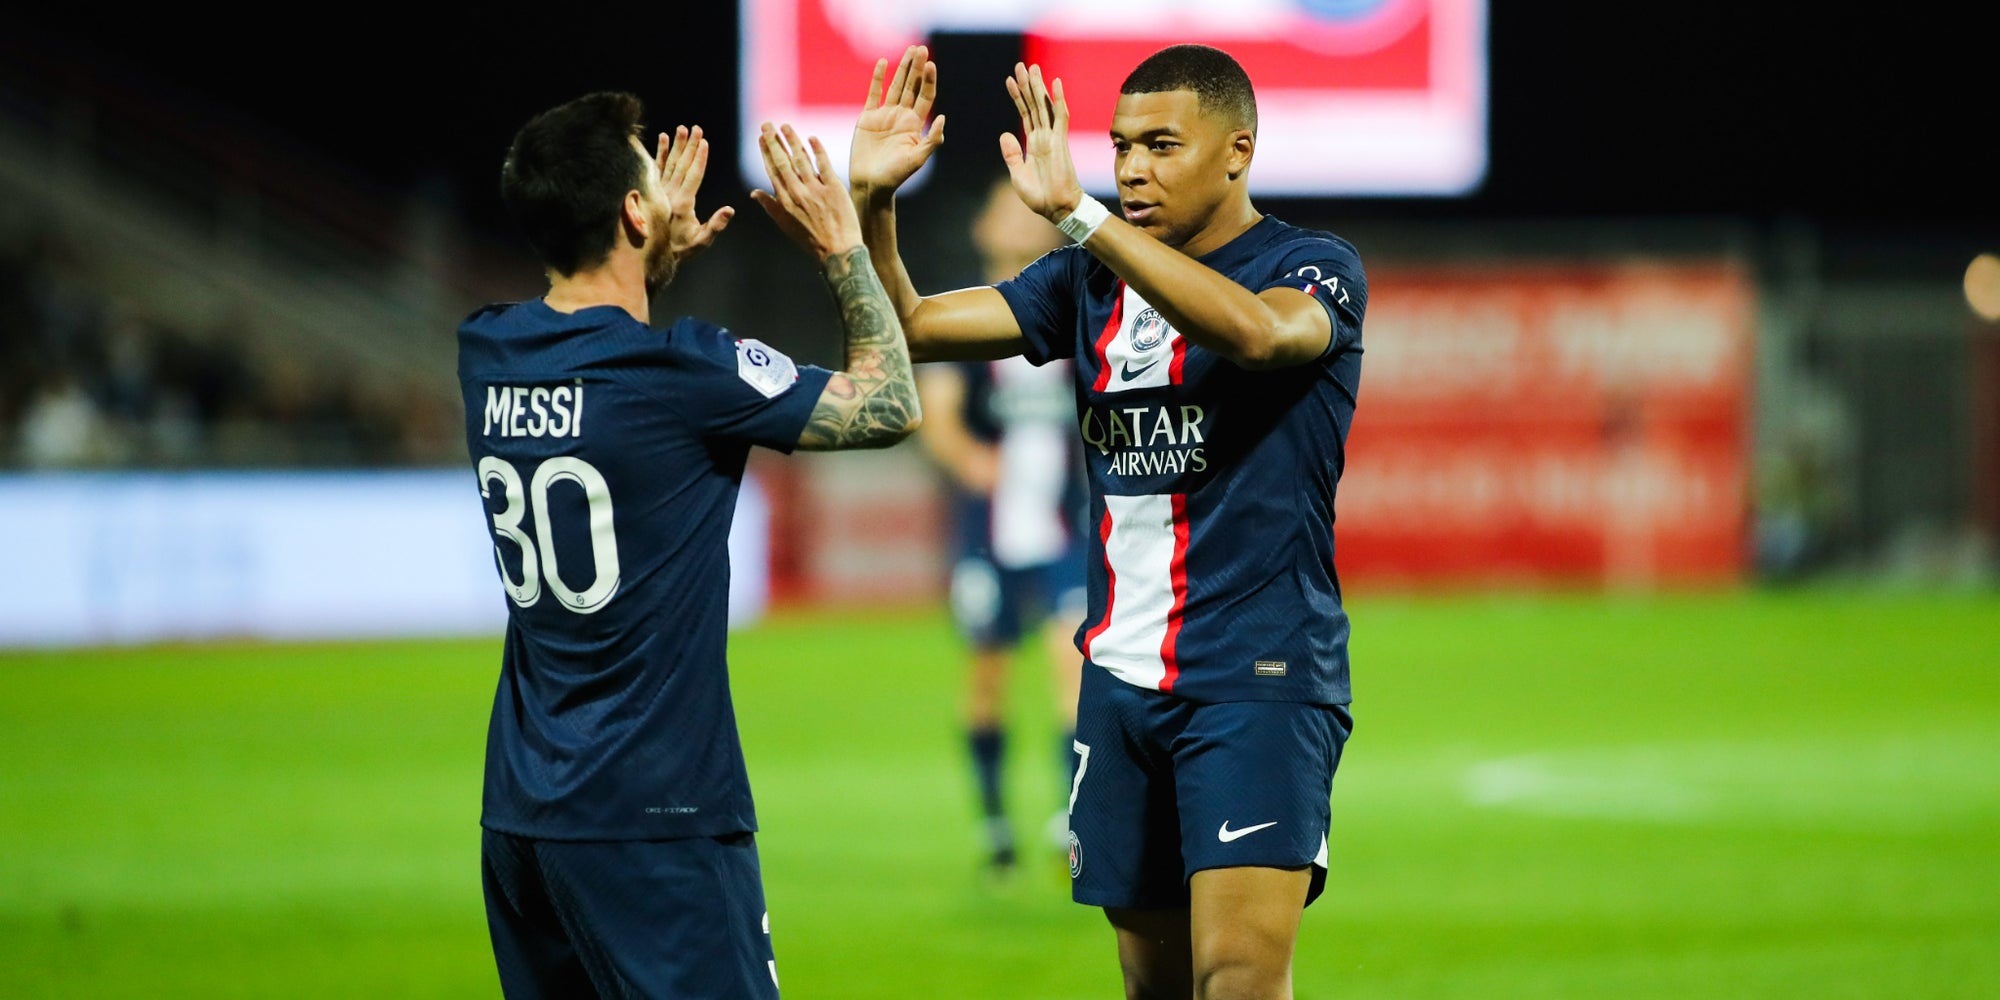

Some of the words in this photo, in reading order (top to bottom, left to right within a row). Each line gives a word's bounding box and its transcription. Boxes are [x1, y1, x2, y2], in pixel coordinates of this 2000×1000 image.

[1284, 265, 1350, 304] OAT
[1081, 404, 1205, 456] QATAR
[1107, 448, 1207, 477] AIRWAYS
[478, 456, 620, 614] 30
[1070, 738, 1090, 815] 7
